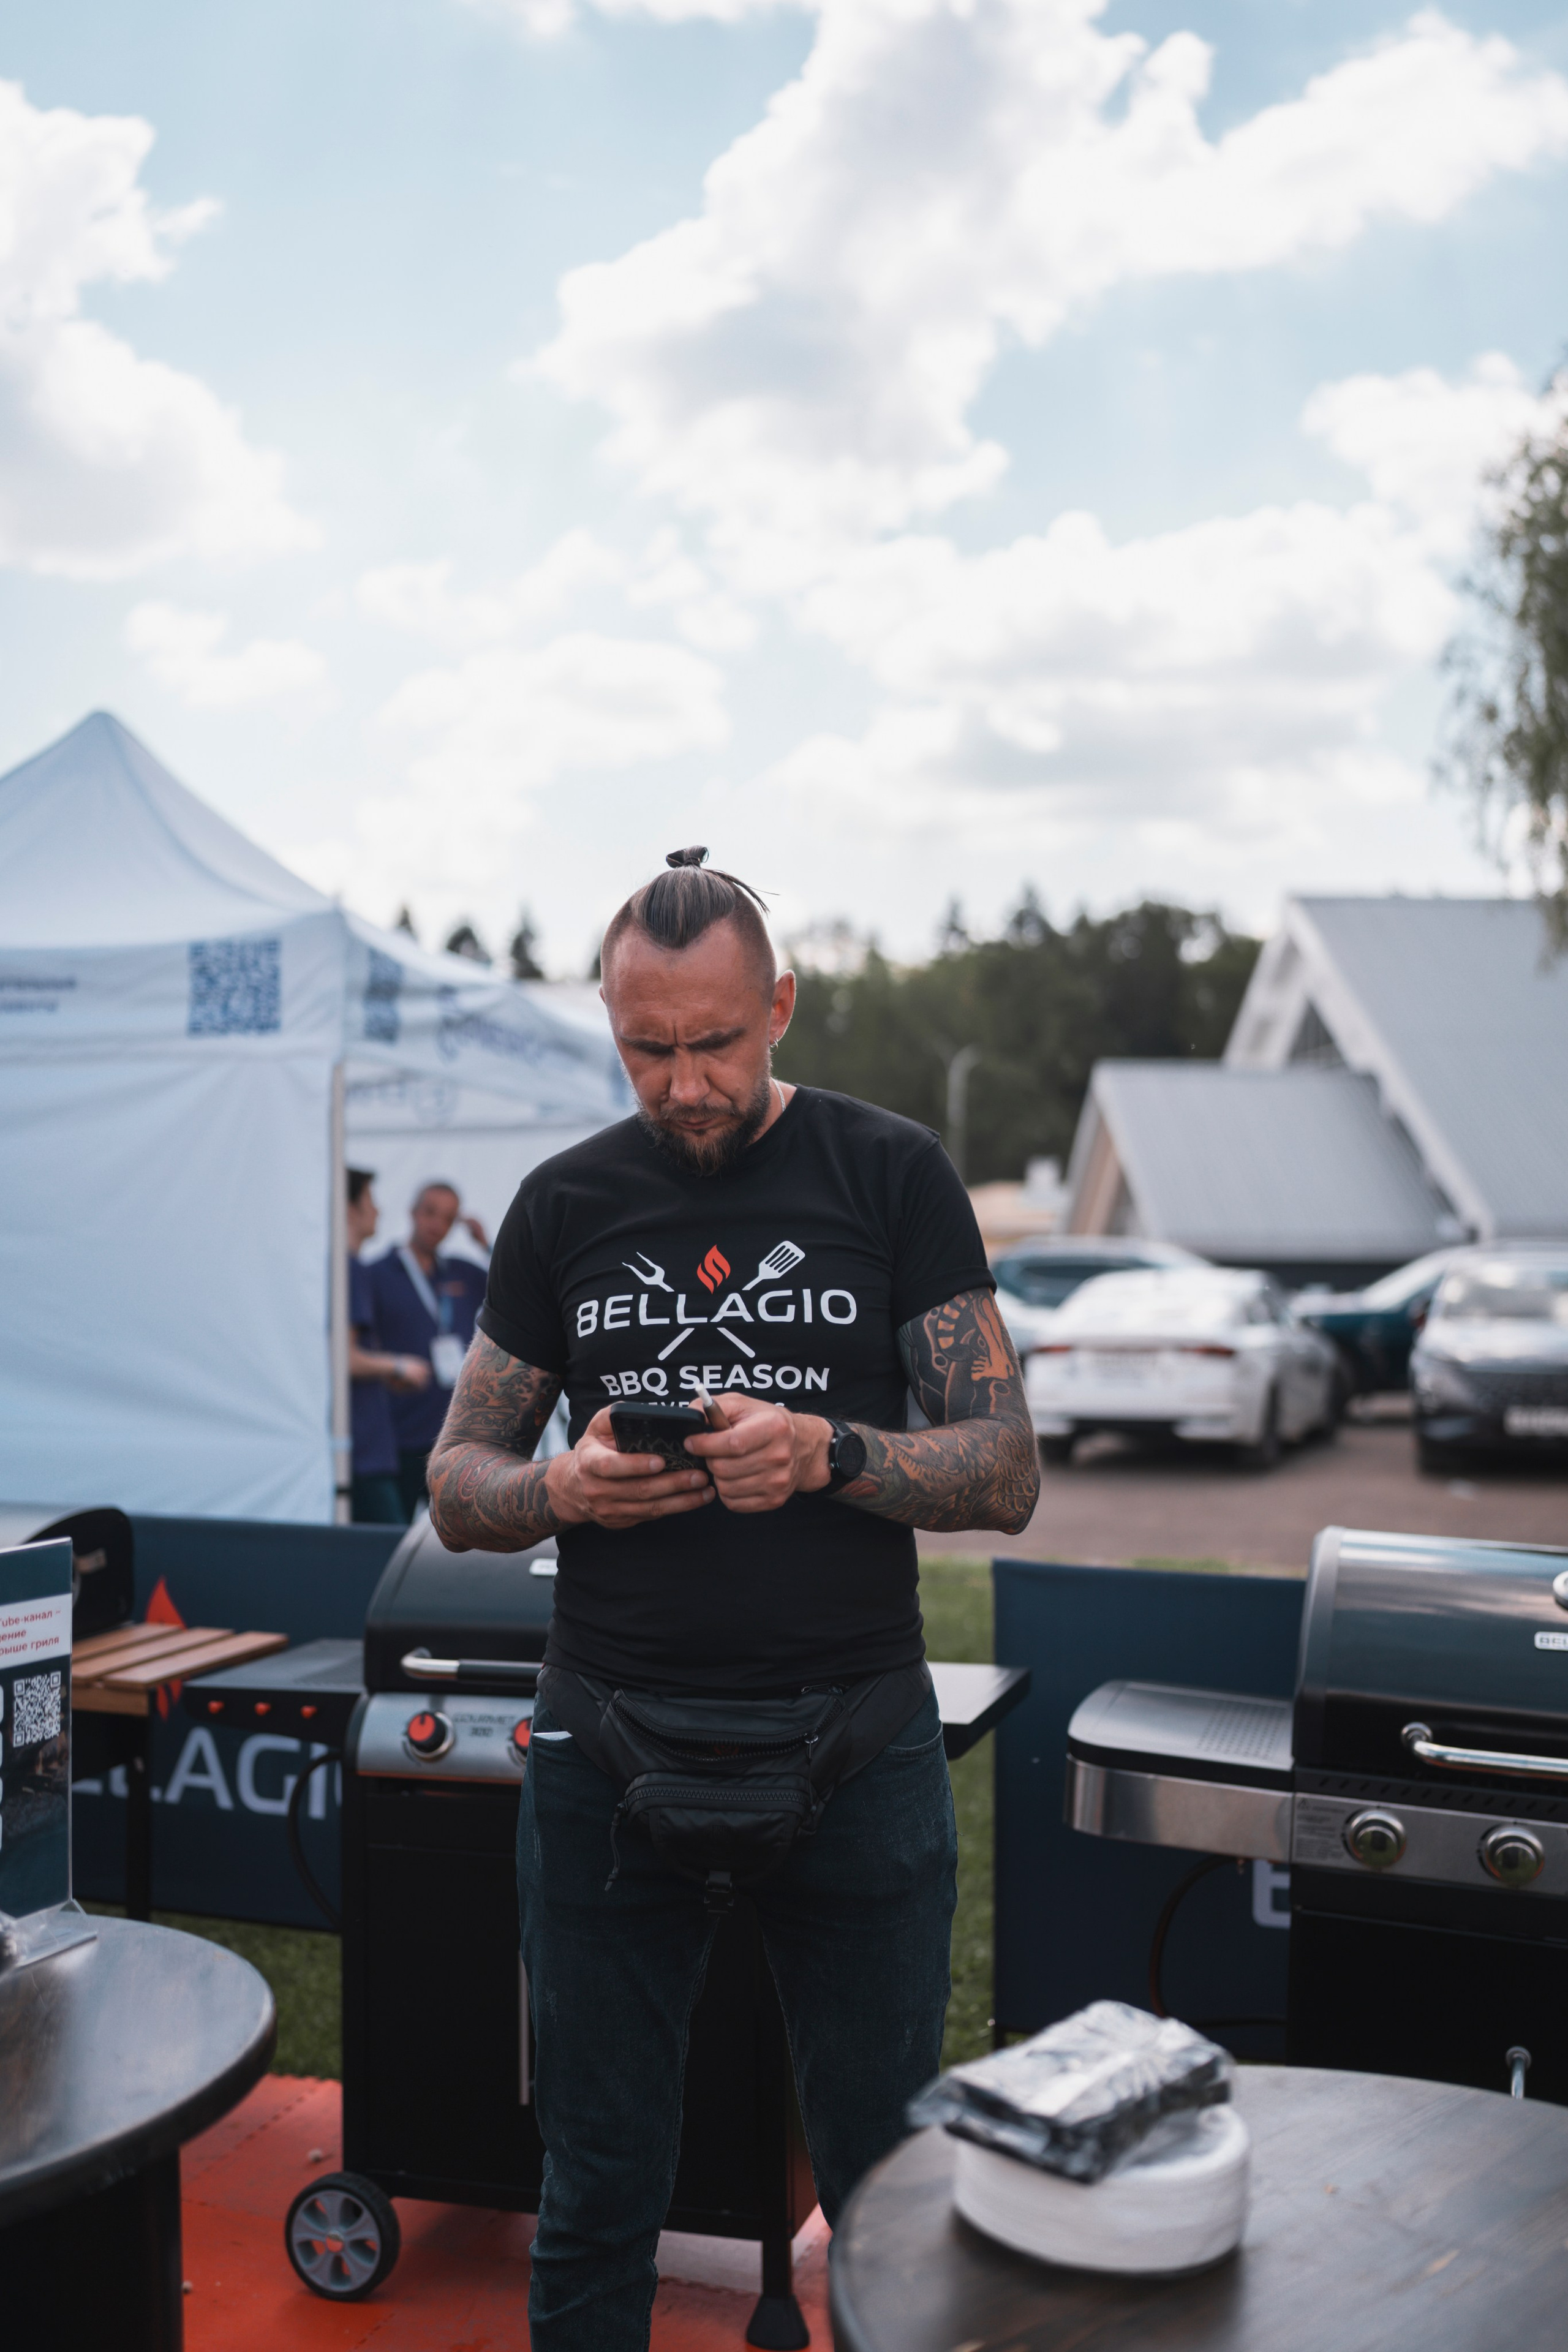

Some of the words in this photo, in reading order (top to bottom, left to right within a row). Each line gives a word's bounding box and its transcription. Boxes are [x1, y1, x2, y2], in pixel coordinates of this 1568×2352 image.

[577, 1289, 857, 1337] BELLAGIO
[600, 1368, 669, 1396] BBQ
[679, 1365, 830, 1391] SEASON
[0, 1610, 53, 1627] ube-канал
[0, 1629, 26, 1643] ение
[31, 1636, 59, 1650] гриля
